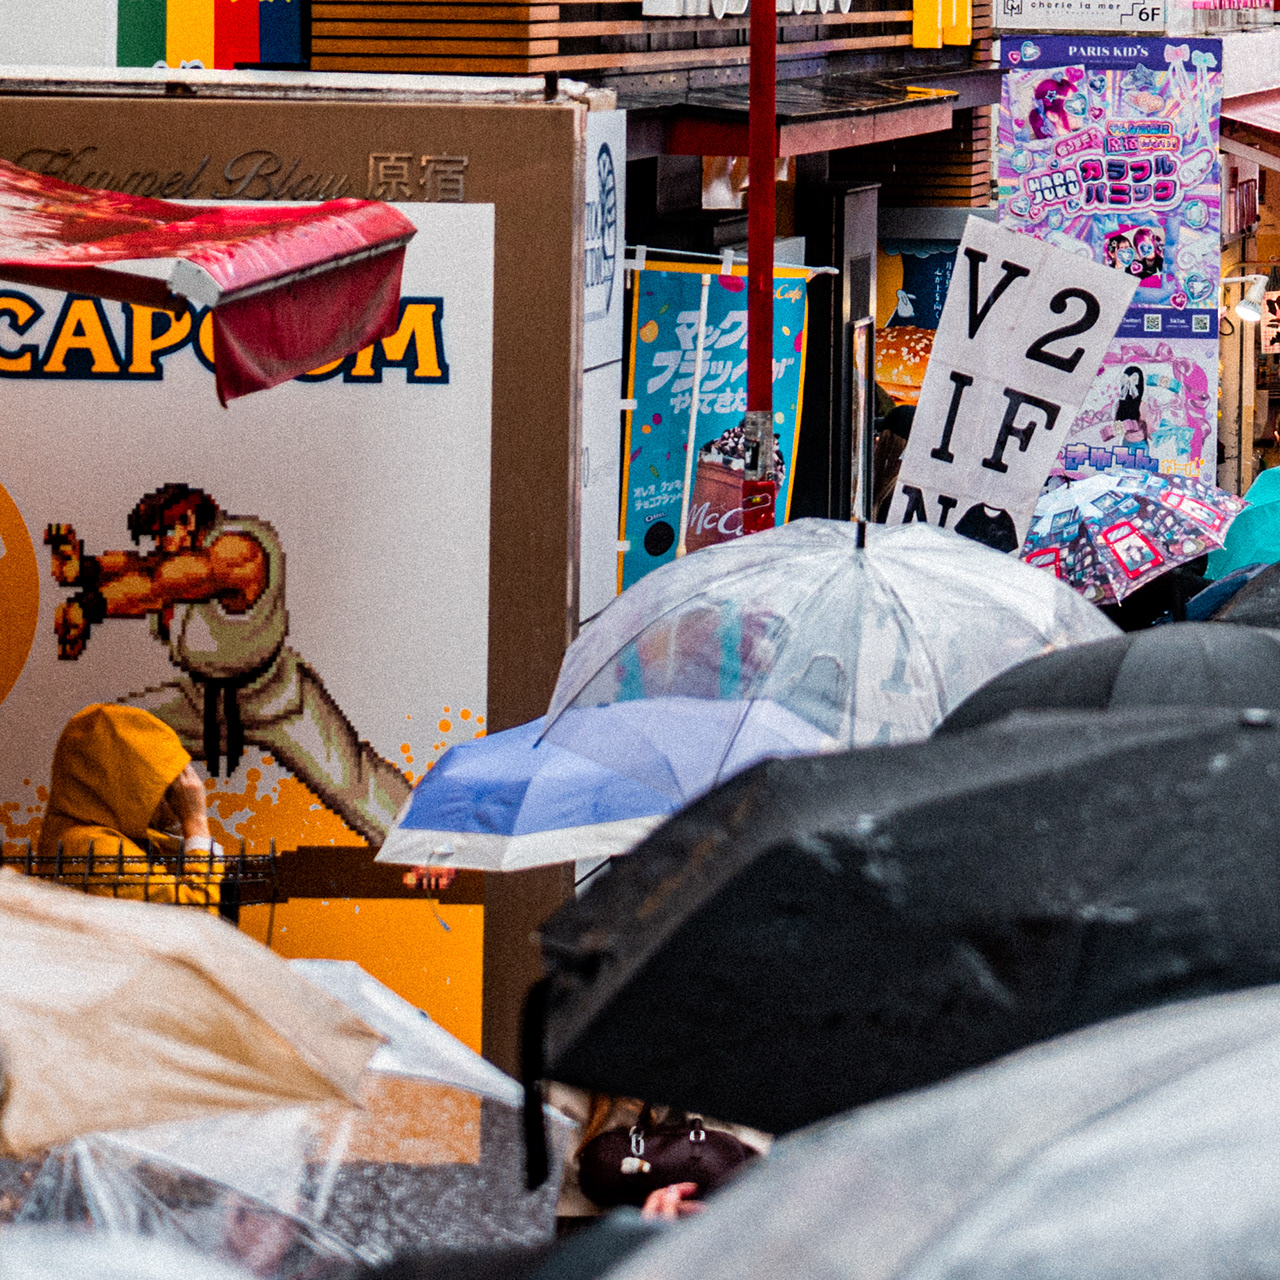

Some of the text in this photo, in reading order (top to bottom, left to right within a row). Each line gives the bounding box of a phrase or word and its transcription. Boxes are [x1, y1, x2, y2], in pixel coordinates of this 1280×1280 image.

[1138, 7, 1161, 22] 6F
[1068, 45, 1149, 58] PARIS KID'S
[367, 151, 470, 202] 原宿
[1079, 154, 1175, 183] カラフル
